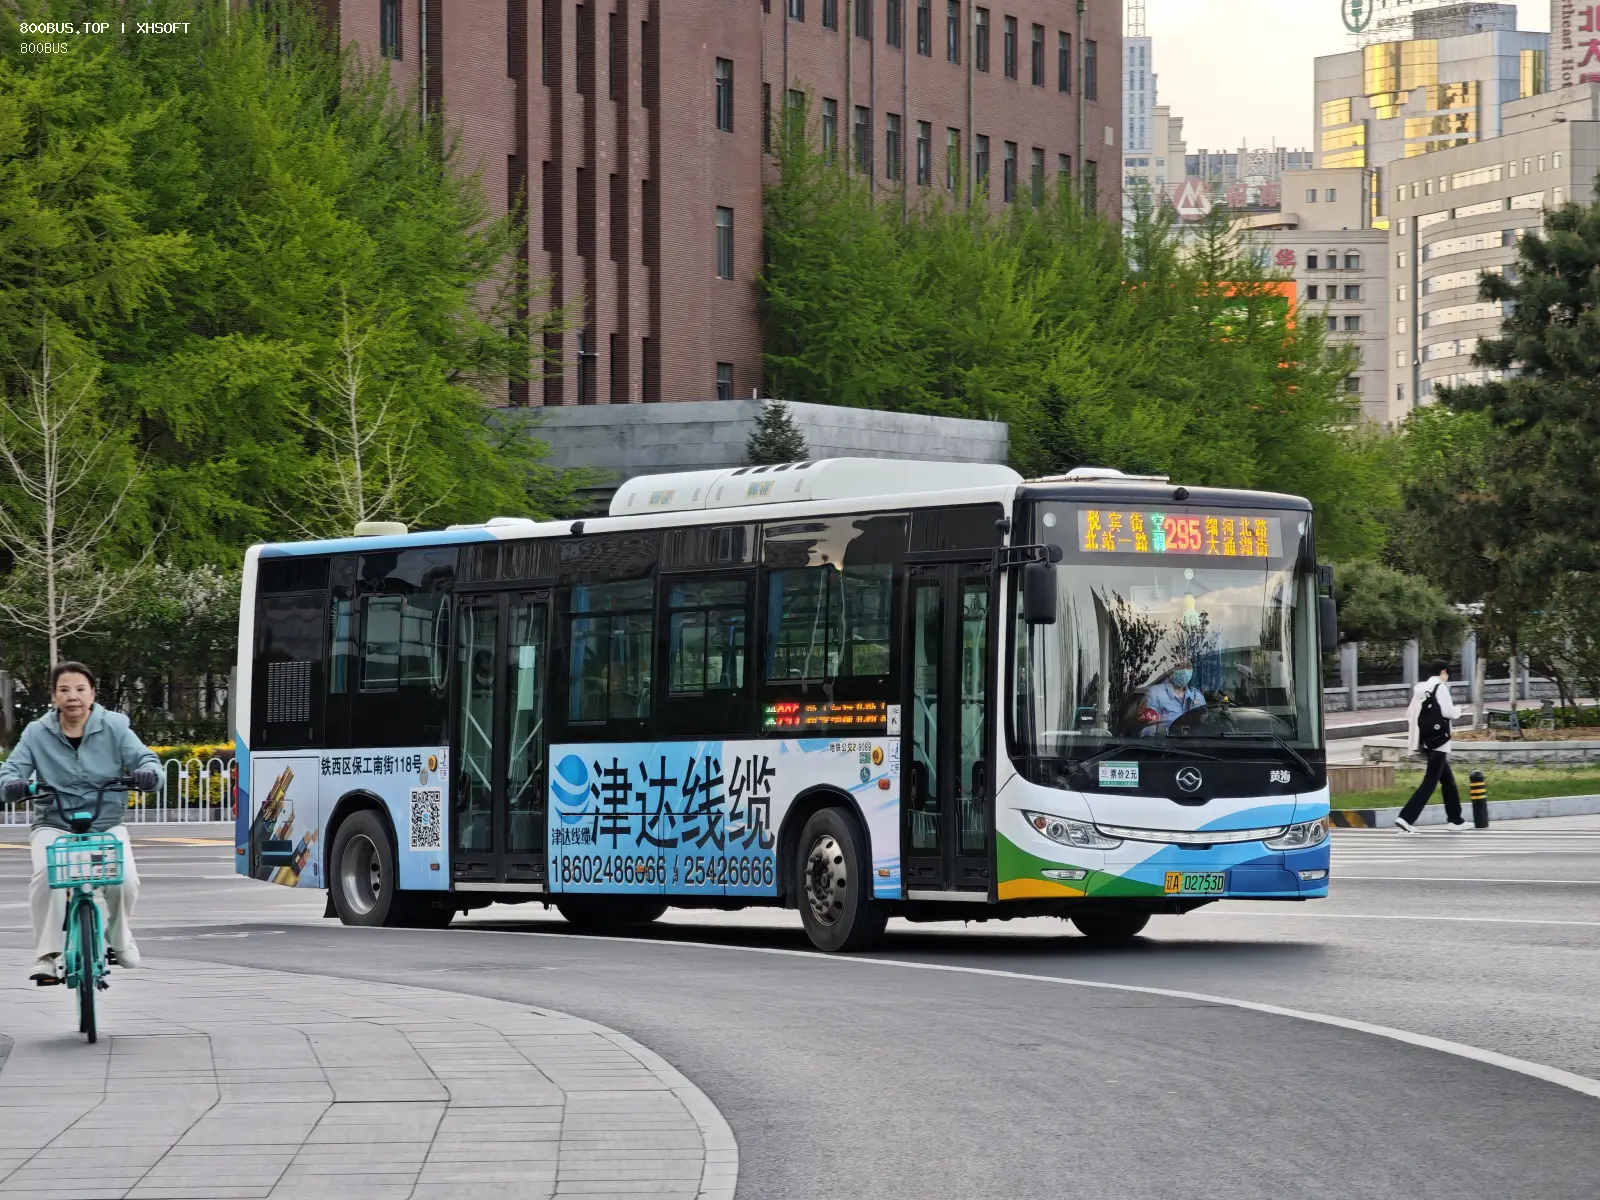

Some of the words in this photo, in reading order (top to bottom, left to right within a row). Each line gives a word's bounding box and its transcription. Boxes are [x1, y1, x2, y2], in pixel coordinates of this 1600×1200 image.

[1274, 248, 1296, 269] 华
[1164, 518, 1202, 551] 295
[1205, 515, 1268, 537] 细河北路
[1085, 529, 1148, 552] 北站一路
[321, 754, 422, 776] 铁西区保工南街118号
[1110, 768, 1138, 780] 票价2元
[590, 754, 776, 851] 津达线缆
[551, 827, 591, 846] 津达线缆
[552, 855, 667, 884] 18602486666
[684, 856, 774, 886] 25426666
